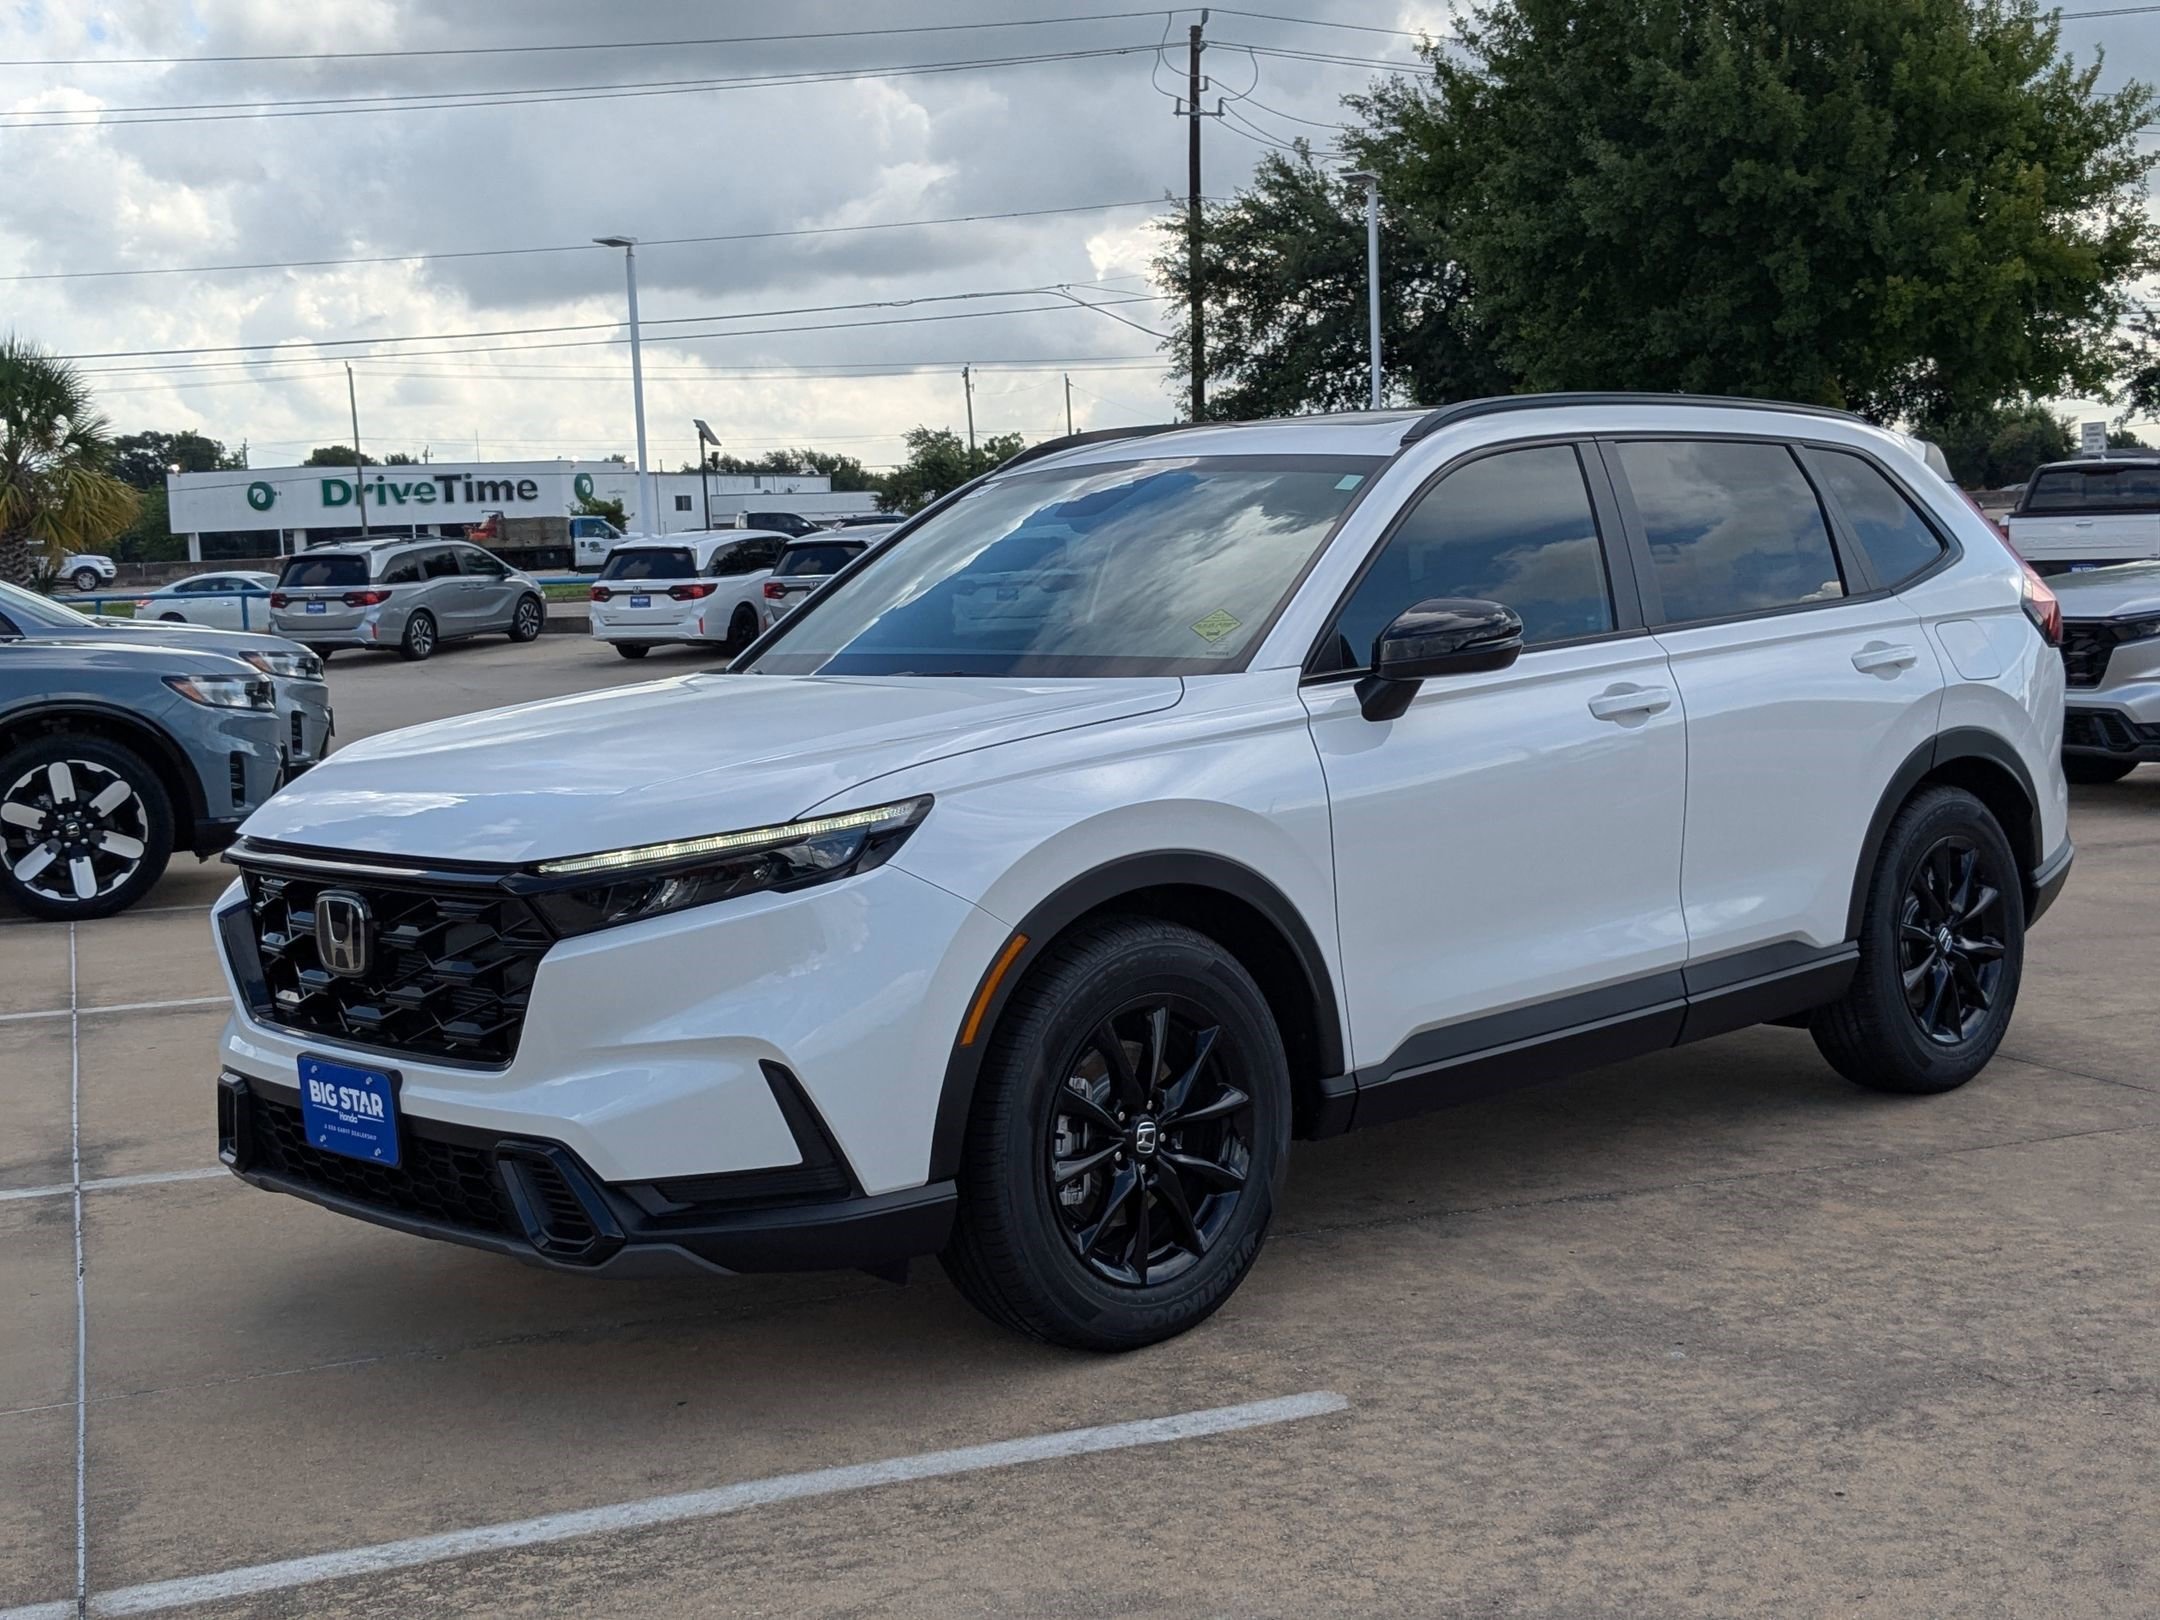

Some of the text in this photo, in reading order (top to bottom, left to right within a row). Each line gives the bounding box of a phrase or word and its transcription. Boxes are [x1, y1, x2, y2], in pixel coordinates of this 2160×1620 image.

[321, 473, 538, 506] DriveTime
[309, 1079, 384, 1118] BIG STAR
[339, 1111, 358, 1124] Honda
